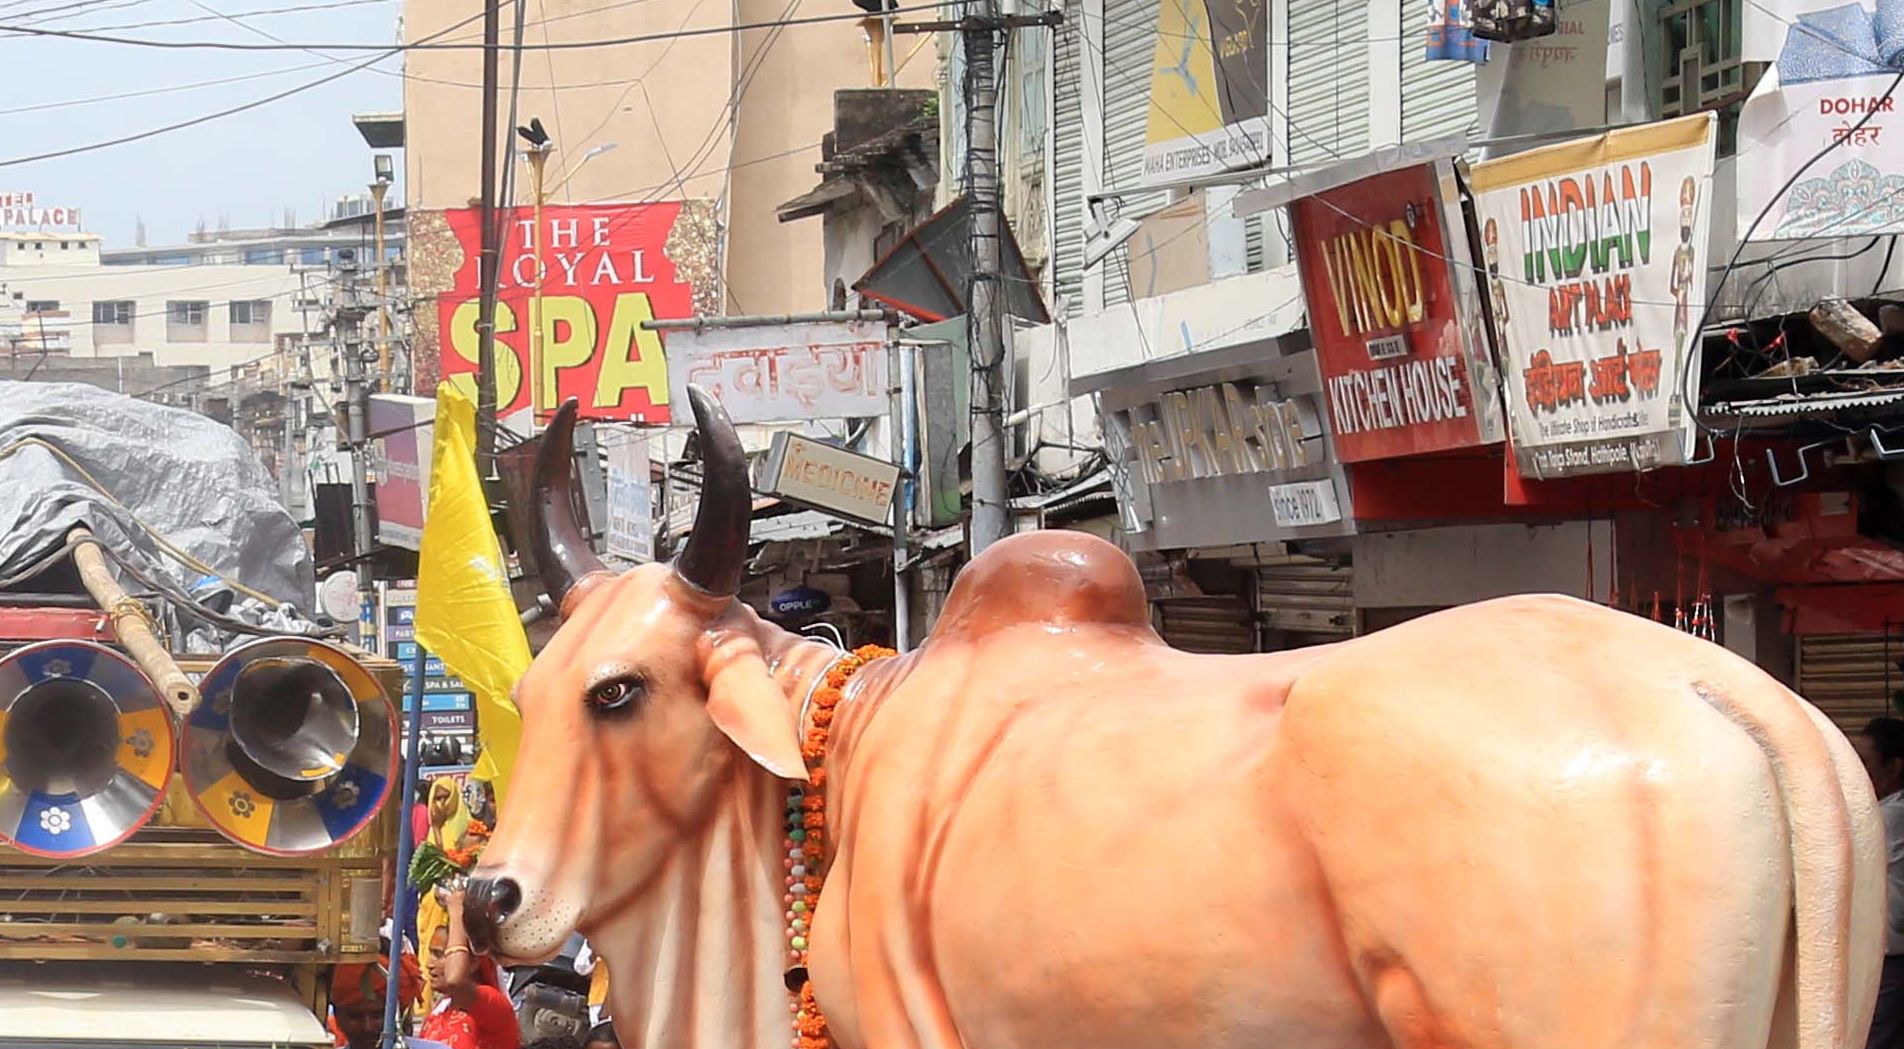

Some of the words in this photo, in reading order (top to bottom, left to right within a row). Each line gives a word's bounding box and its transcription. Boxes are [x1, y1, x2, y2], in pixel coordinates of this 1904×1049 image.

[1819, 96, 1895, 115] DOHAR
[515, 216, 612, 250] THE
[1520, 160, 1652, 286] INDIAN
[1320, 219, 1425, 337] VINOD
[450, 291, 671, 412] SPA
[1328, 366, 1405, 436] KITCHEN
[1399, 356, 1468, 425] HOUSE
[783, 456, 892, 508] MEDICINE
[432, 715, 465, 724] TOILETS
